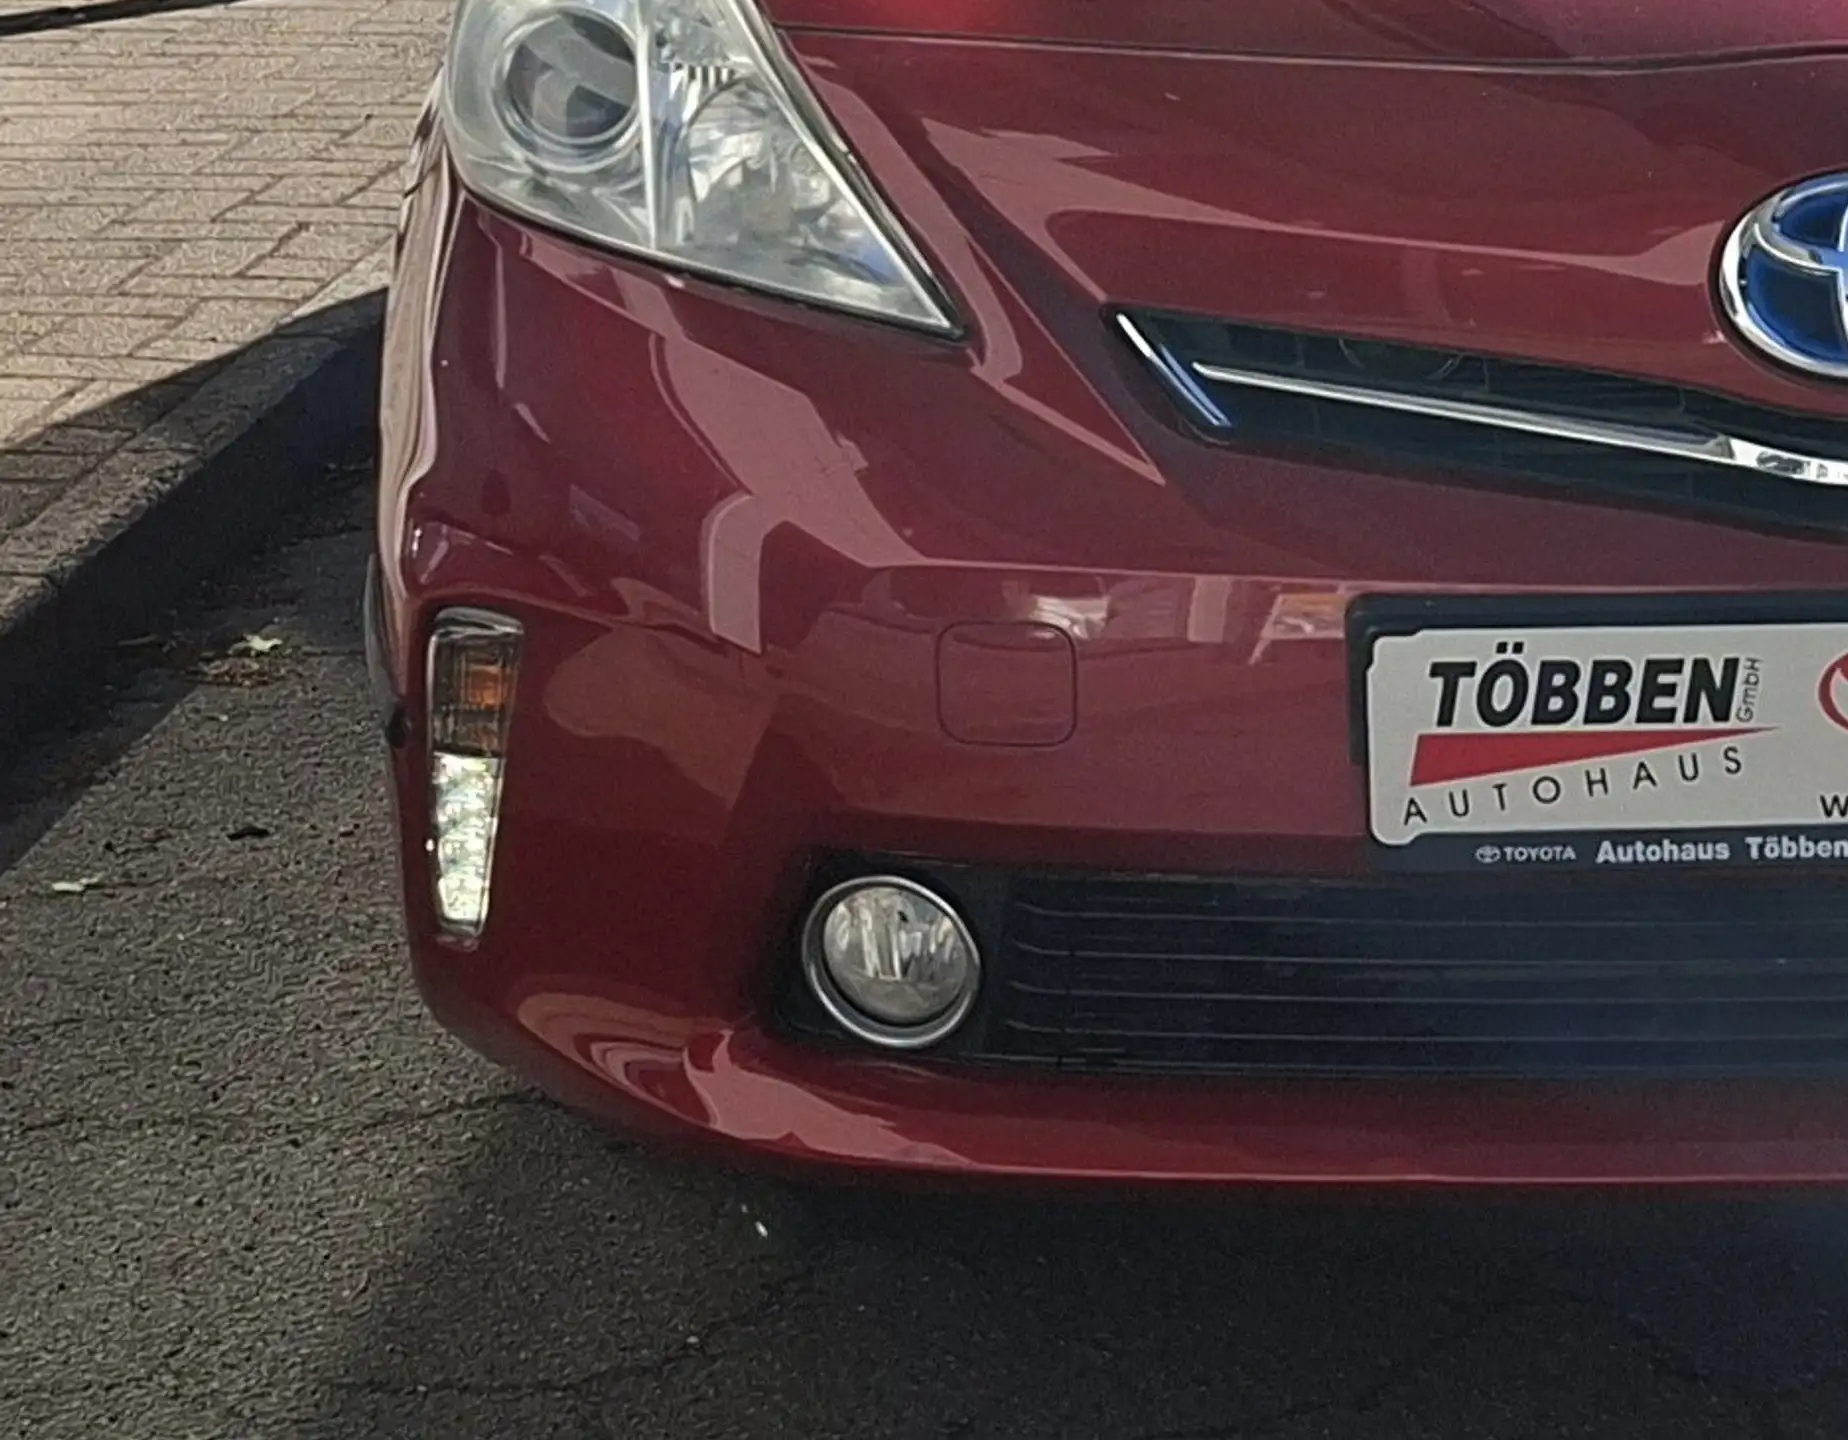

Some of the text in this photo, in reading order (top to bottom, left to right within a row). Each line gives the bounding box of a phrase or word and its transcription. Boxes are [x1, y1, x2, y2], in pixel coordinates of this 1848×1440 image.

[1429, 641, 1740, 727] TÖBBEN
[1735, 657, 1763, 723] GmbH
[1403, 746, 1742, 826] AUTOHAUS
[1504, 845, 1576, 862] TOYOTA
[1595, 837, 1731, 864] Autohaus
